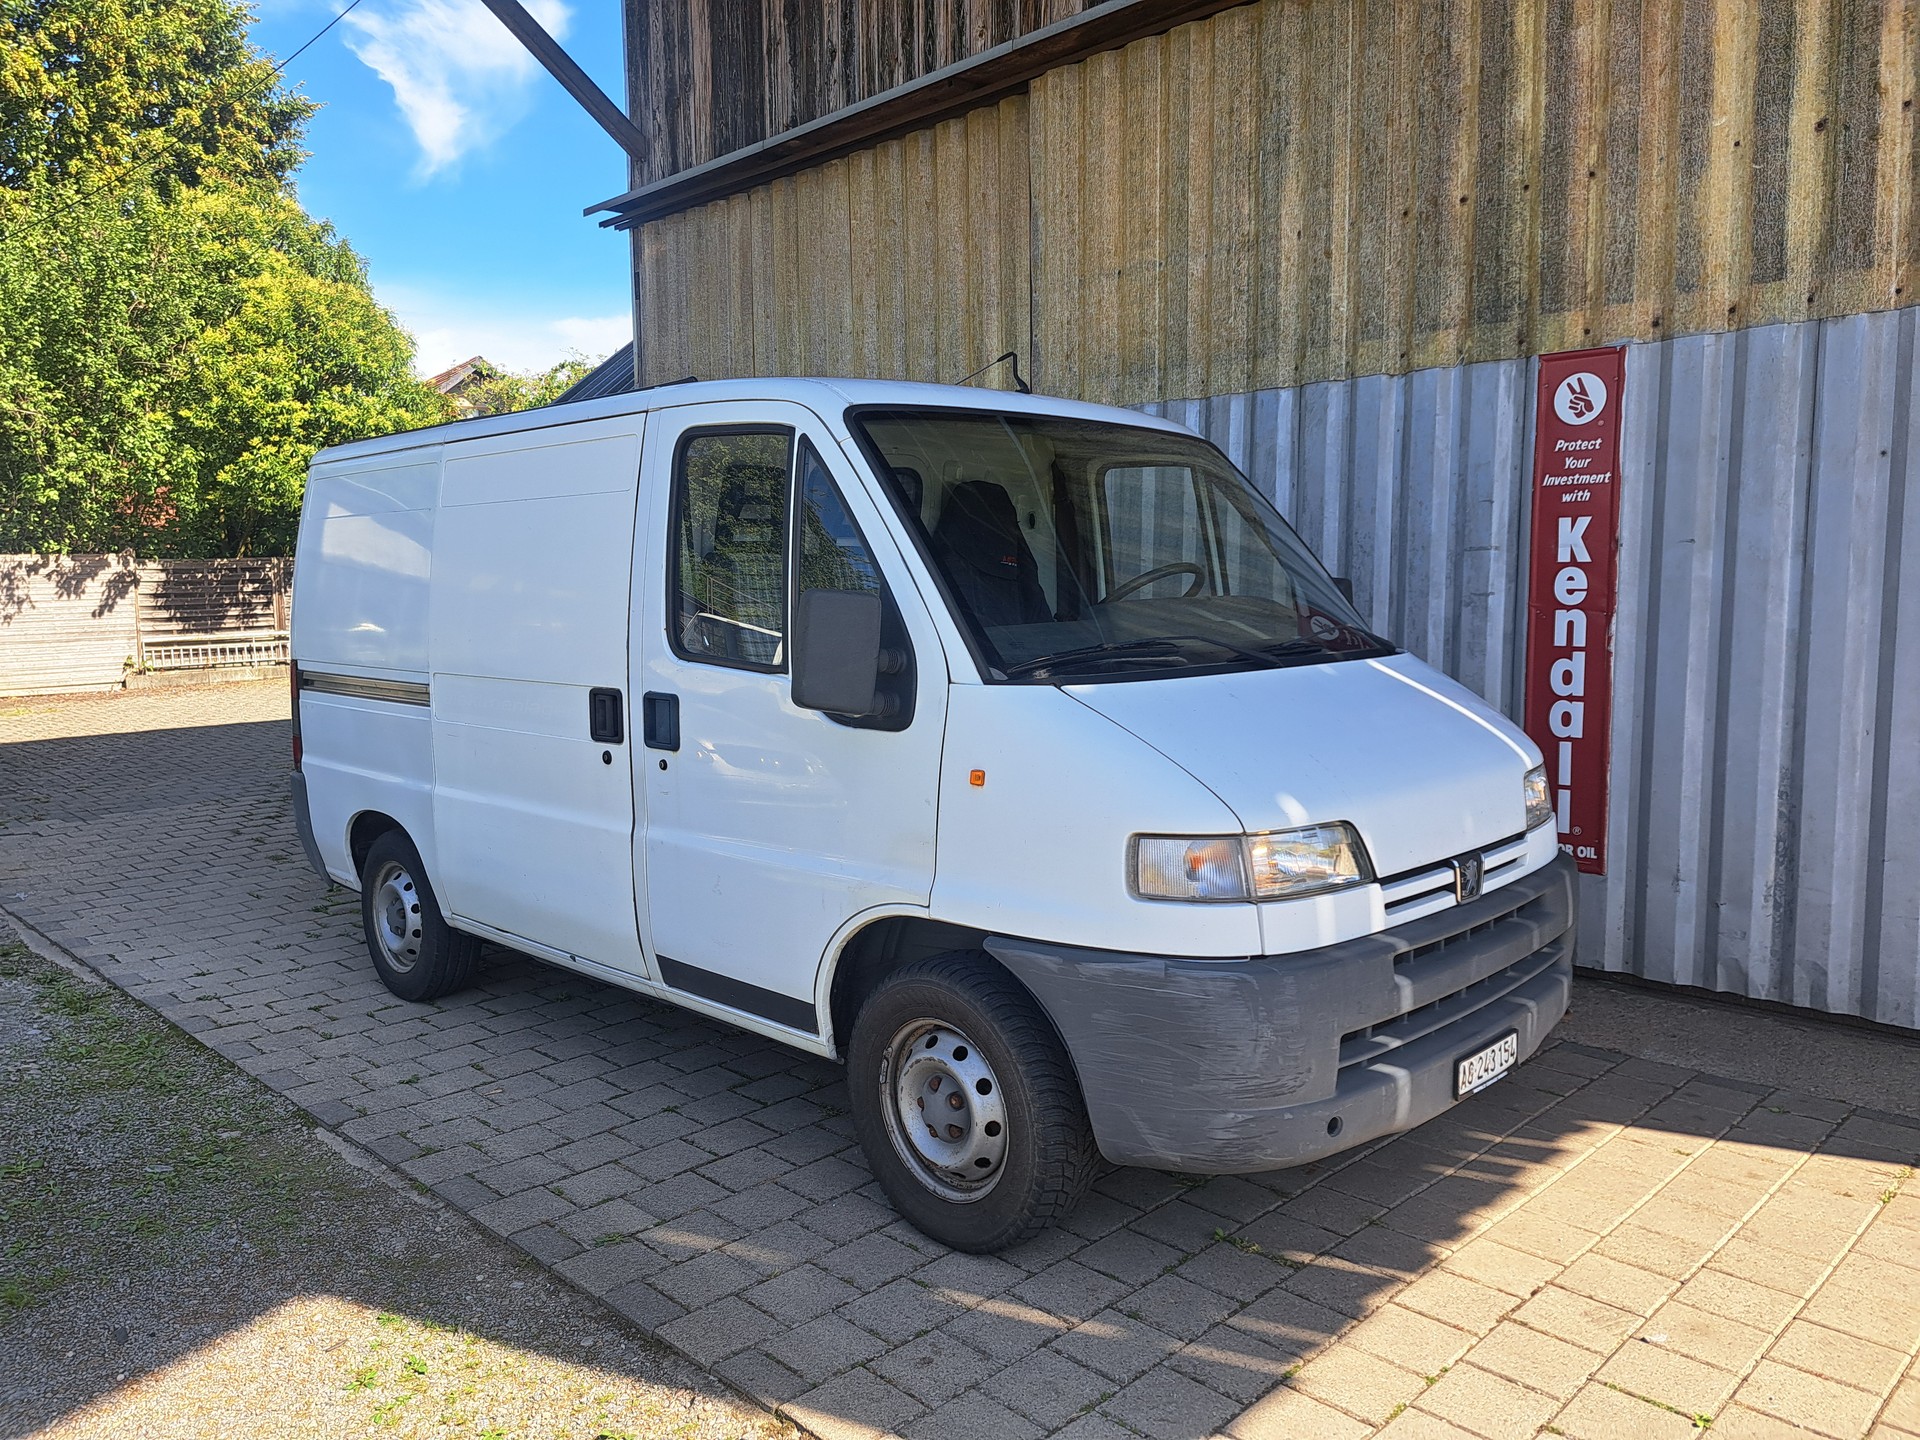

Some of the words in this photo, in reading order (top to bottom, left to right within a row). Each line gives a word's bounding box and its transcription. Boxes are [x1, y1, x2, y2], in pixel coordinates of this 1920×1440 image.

[1554, 437, 1602, 452] Protect
[1564, 456, 1591, 469] Your
[1542, 471, 1612, 486] Investment
[1561, 489, 1591, 503] with
[1550, 515, 1592, 835] Kendall
[1577, 845, 1598, 859] OIL
